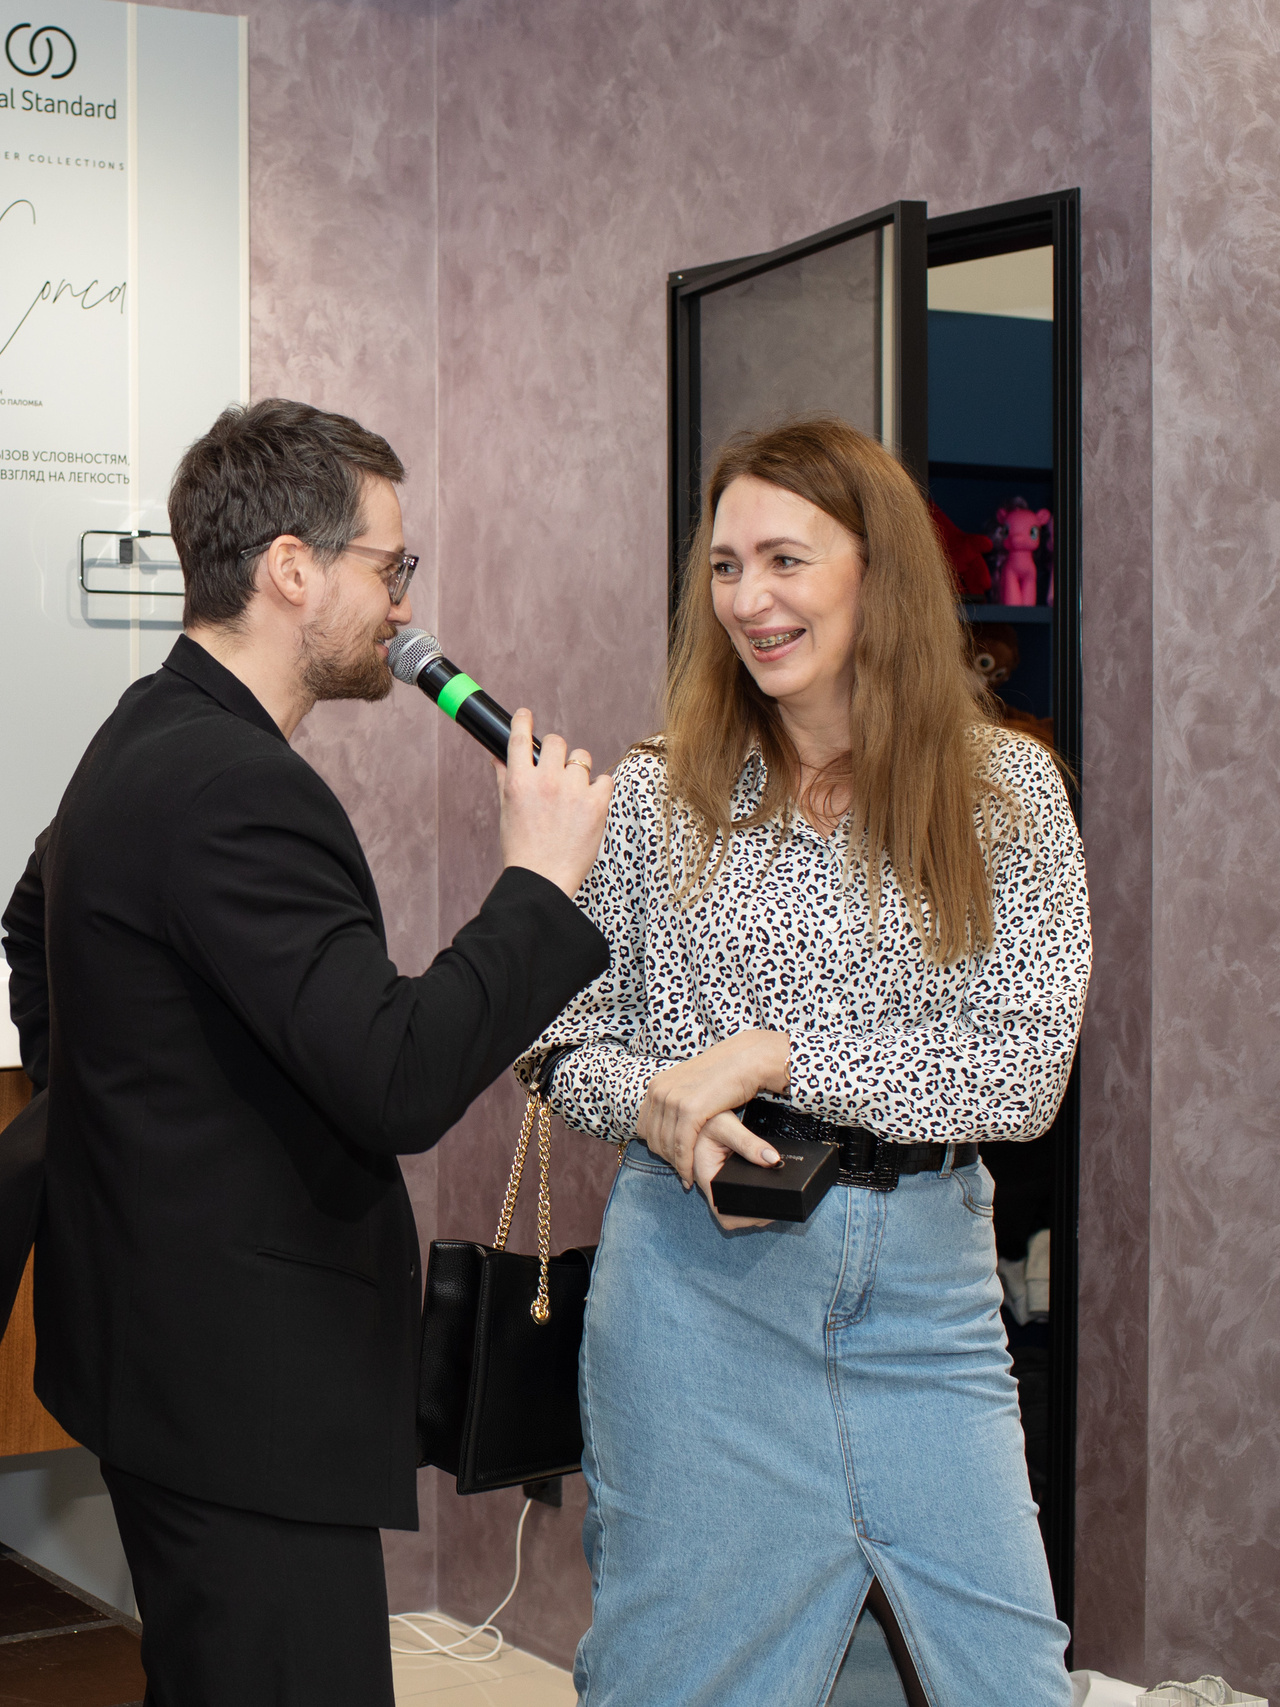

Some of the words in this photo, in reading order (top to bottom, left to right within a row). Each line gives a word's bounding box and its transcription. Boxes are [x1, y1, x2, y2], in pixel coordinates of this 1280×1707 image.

[21, 89, 117, 120] Standard
[28, 153, 126, 171] COLLECTIONS
[7, 398, 43, 407] ПАЛОМБА
[32, 451, 130, 466] УСЛОВНОСТЯМ,
[0, 469, 45, 483] ВЗГЛЯД
[48, 471, 65, 482] НА
[68, 472, 130, 485] ЛЕГКОСТЬ
